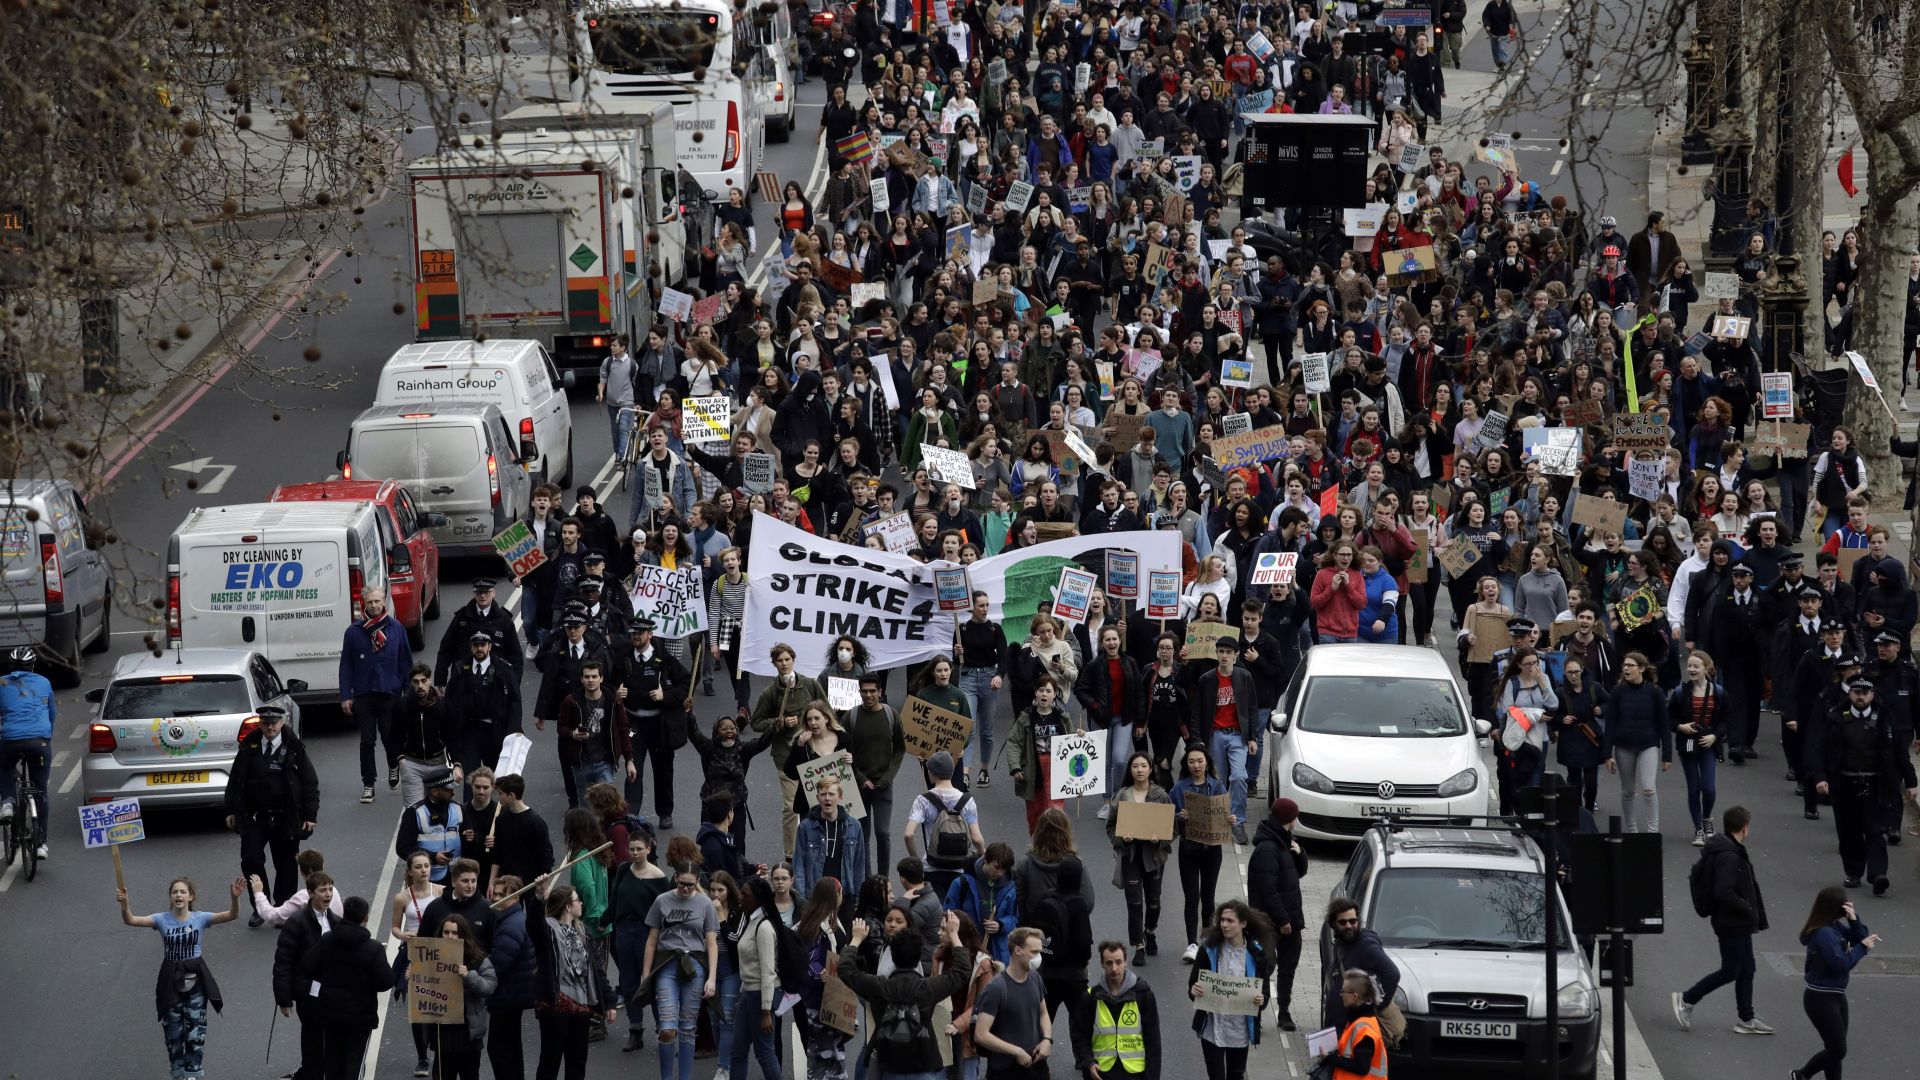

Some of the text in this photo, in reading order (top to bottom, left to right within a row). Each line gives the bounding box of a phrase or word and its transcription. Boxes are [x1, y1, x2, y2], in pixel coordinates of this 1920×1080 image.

[506, 183, 524, 192] AIR
[467, 192, 524, 201] PRODUCTS
[431, 252, 444, 261] 2T
[424, 264, 452, 273] 2187
[398, 378, 496, 390] Rainham Group
[694, 404, 728, 415] ANGRY
[685, 427, 729, 439] ATTENTION
[1214, 427, 1280, 451] MARCH NOW
[1616, 436, 1666, 447] EMISSIONS
[1235, 443, 1266, 460] SWIM
[946, 474, 971, 485] HOUSE
[1643, 474, 1658, 482] THEM
[494, 521, 529, 551] NATURE
[223, 548, 302, 564] DRY CLEANING BY
[512, 549, 546, 576] OVER
[1278, 553, 1295, 568] UR
[225, 562, 303, 590] EKO
[1068, 578, 1088, 587] SOCIALIST
[1254, 569, 1293, 582] FUTURE
[211, 588, 318, 603] MASTERS OF HOFFMAN PRESS
[635, 582, 681, 604] HOT IN
[770, 573, 933, 624] STRIKE 4
[652, 601, 670, 615] SO
[634, 609, 698, 636] ACTION
[769, 605, 925, 641] CLIMATE
[830, 679, 846, 691] STOP
[912, 702, 932, 718] WE
[935, 715, 948, 725] ARE
[912, 716, 965, 742] NEXT GENERATION
[903, 732, 932, 751] AVE NO
[935, 734, 952, 749] WE
[1060, 740, 1099, 760] SOLUTION
[153, 772, 202, 784] GL17 ZBT
[1060, 776, 1098, 794] POLLUTION
[82, 808, 105, 819] I've
[106, 802, 138, 815] Seen
[1204, 807, 1227, 815] SCHOOL
[83, 817, 115, 829] BETTER
[88, 827, 139, 845] AT IKEA
[668, 909, 694, 920] NIKE
[167, 926, 186, 935] LIKE
[415, 946, 440, 962] THE
[436, 963, 459, 974] END
[1200, 971, 1252, 989] Environment
[1212, 985, 1238, 998] People
[418, 1002, 448, 1013] NIGH
[1446, 1023, 1512, 1037] RK55 UCO
